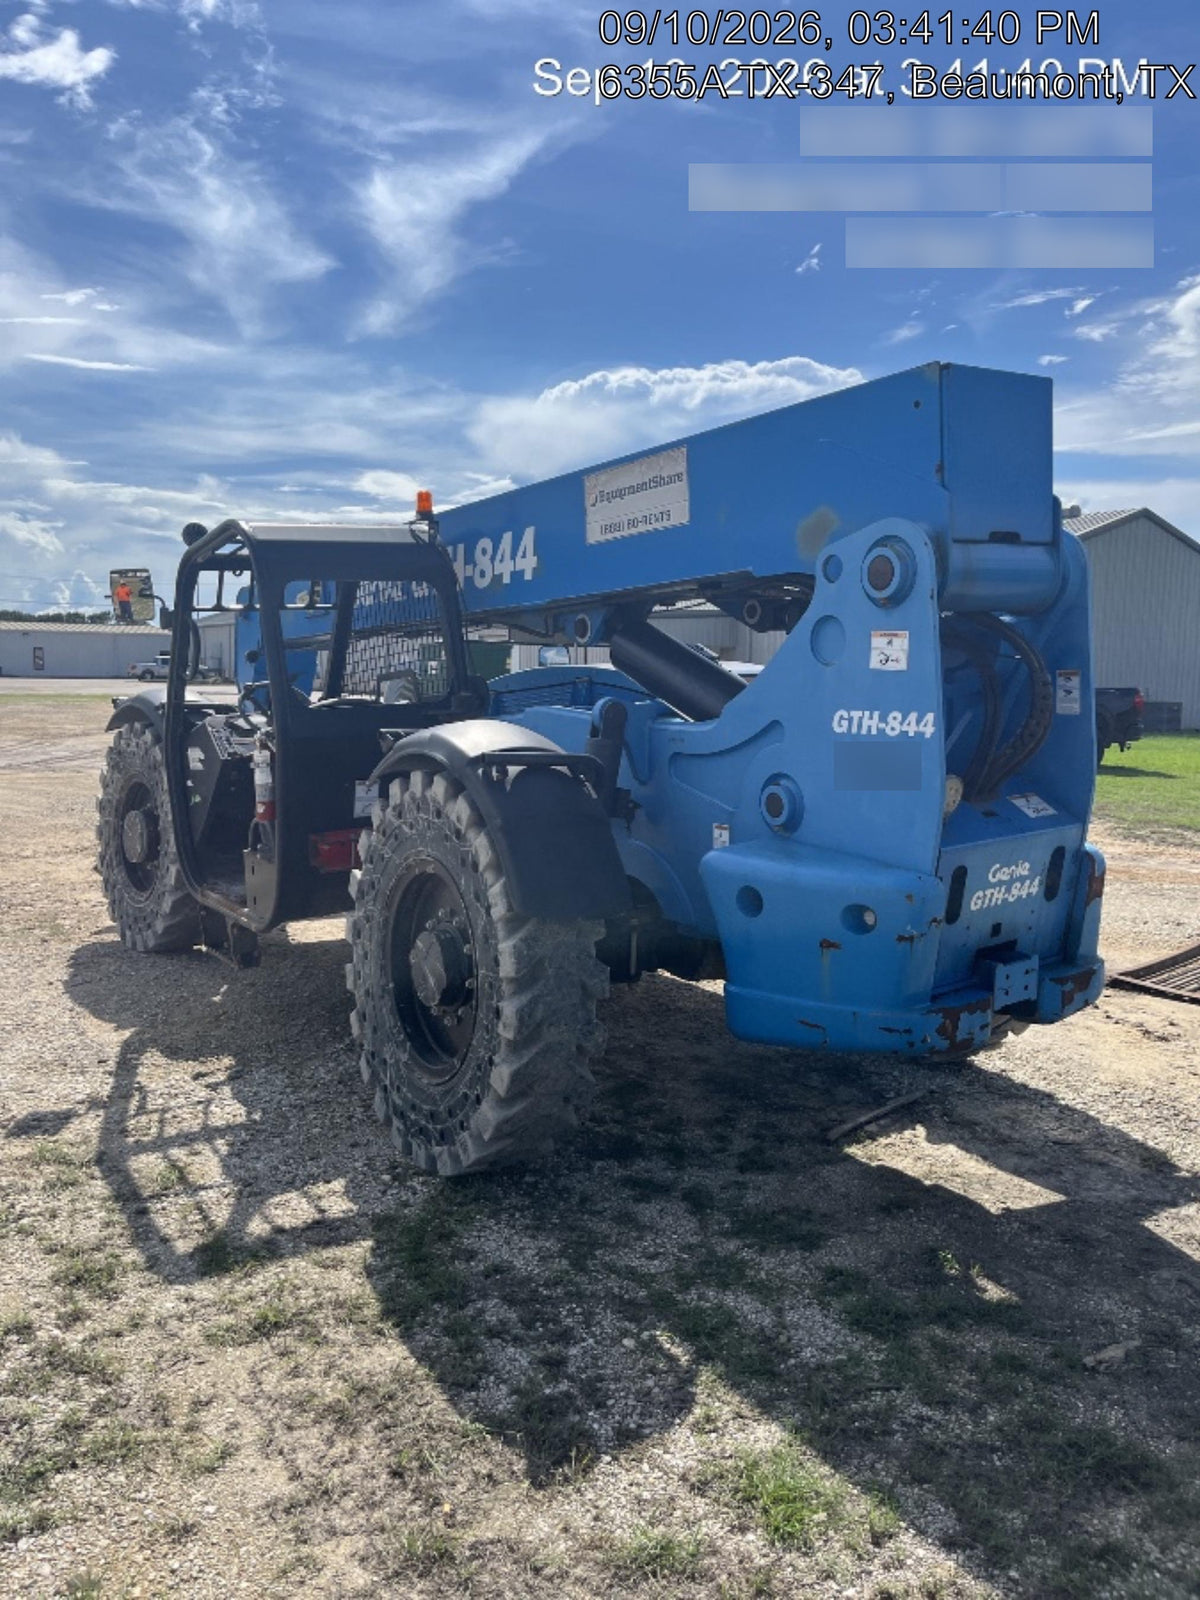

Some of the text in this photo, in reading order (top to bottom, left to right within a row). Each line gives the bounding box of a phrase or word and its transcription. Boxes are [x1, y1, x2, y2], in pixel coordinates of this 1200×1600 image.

[598, 472, 684, 504] EquipmentShare
[448, 525, 538, 592] H-844
[831, 709, 936, 738] GTH-844
[988, 860, 1031, 883] Genie
[970, 876, 1041, 911] GTH-844
